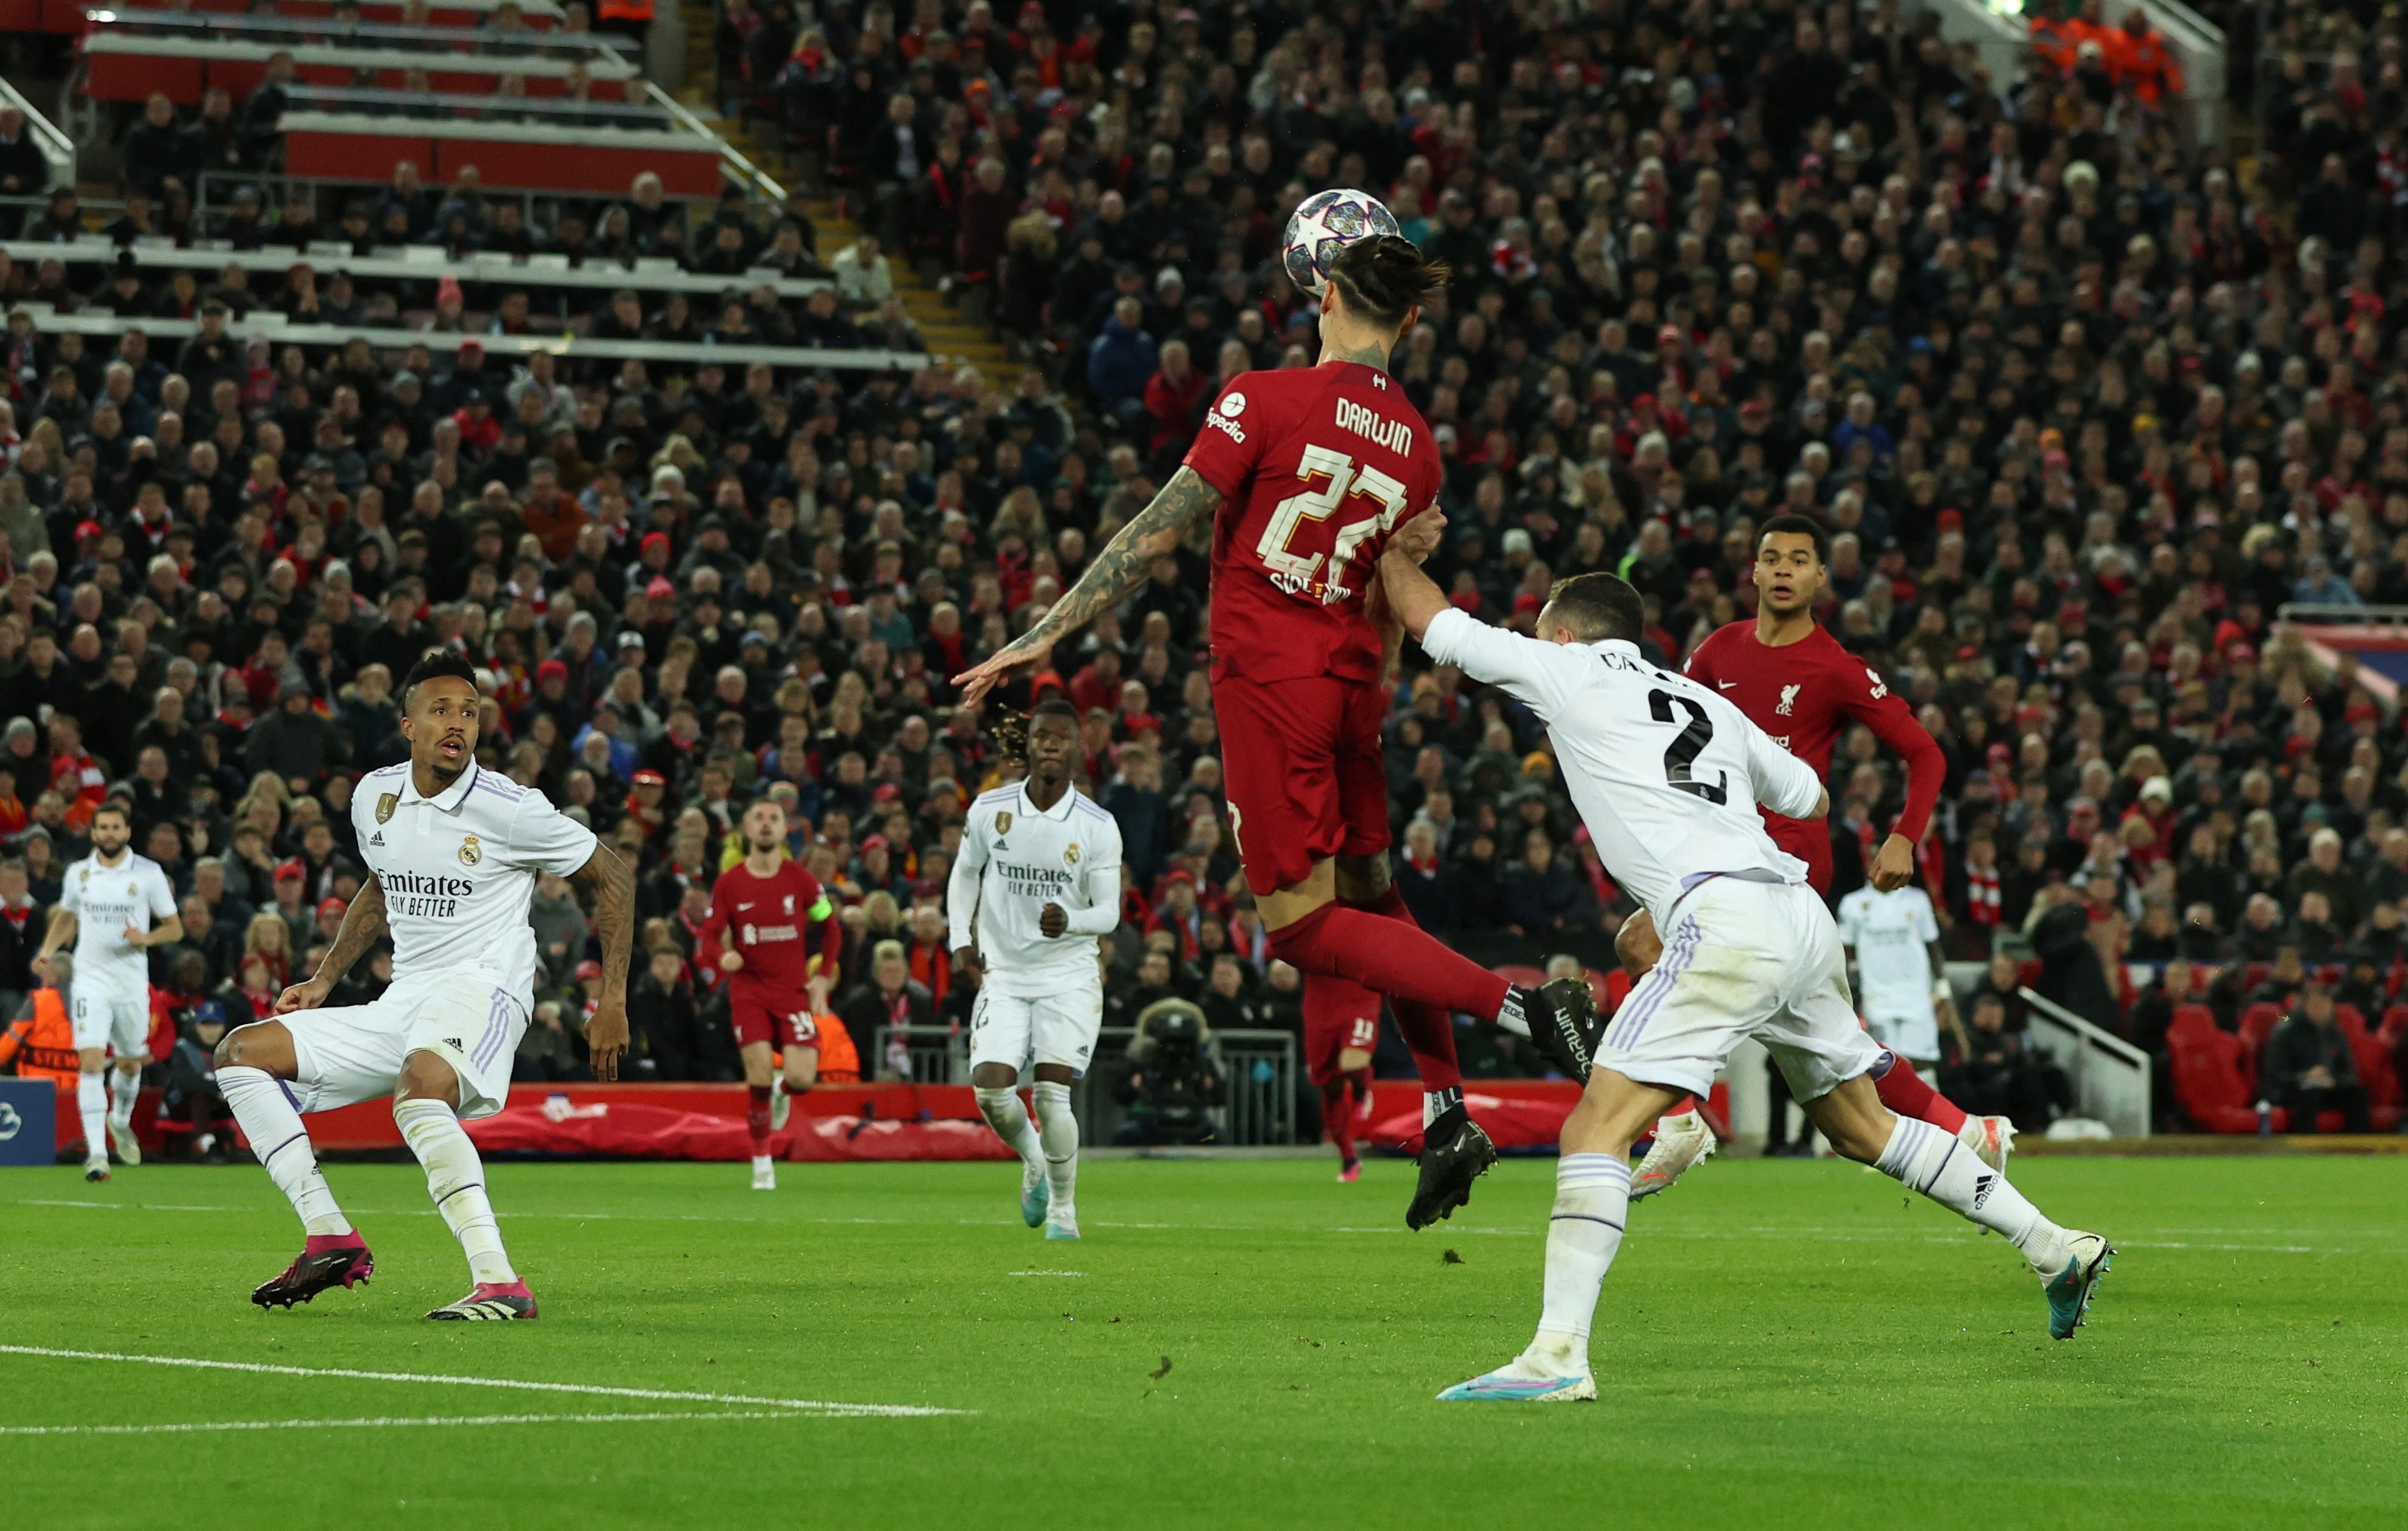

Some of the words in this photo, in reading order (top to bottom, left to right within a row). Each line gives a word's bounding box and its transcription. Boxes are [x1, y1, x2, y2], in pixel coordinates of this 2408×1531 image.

[1335, 397, 1412, 458] DARWIN
[1256, 443, 1407, 585] 27
[1775, 703, 1793, 717] LFC
[1648, 688, 1727, 806] 2
[378, 869, 473, 897] Emirates
[996, 860, 1073, 884] Emirates
[1007, 881, 1024, 896] FLY
[1026, 882, 1063, 897] BETTER
[390, 895, 405, 914] FLY
[409, 897, 456, 918] BETTER
[1554, 1007, 1593, 1075] DARWIN
[1975, 1174, 2000, 1210] adidas
